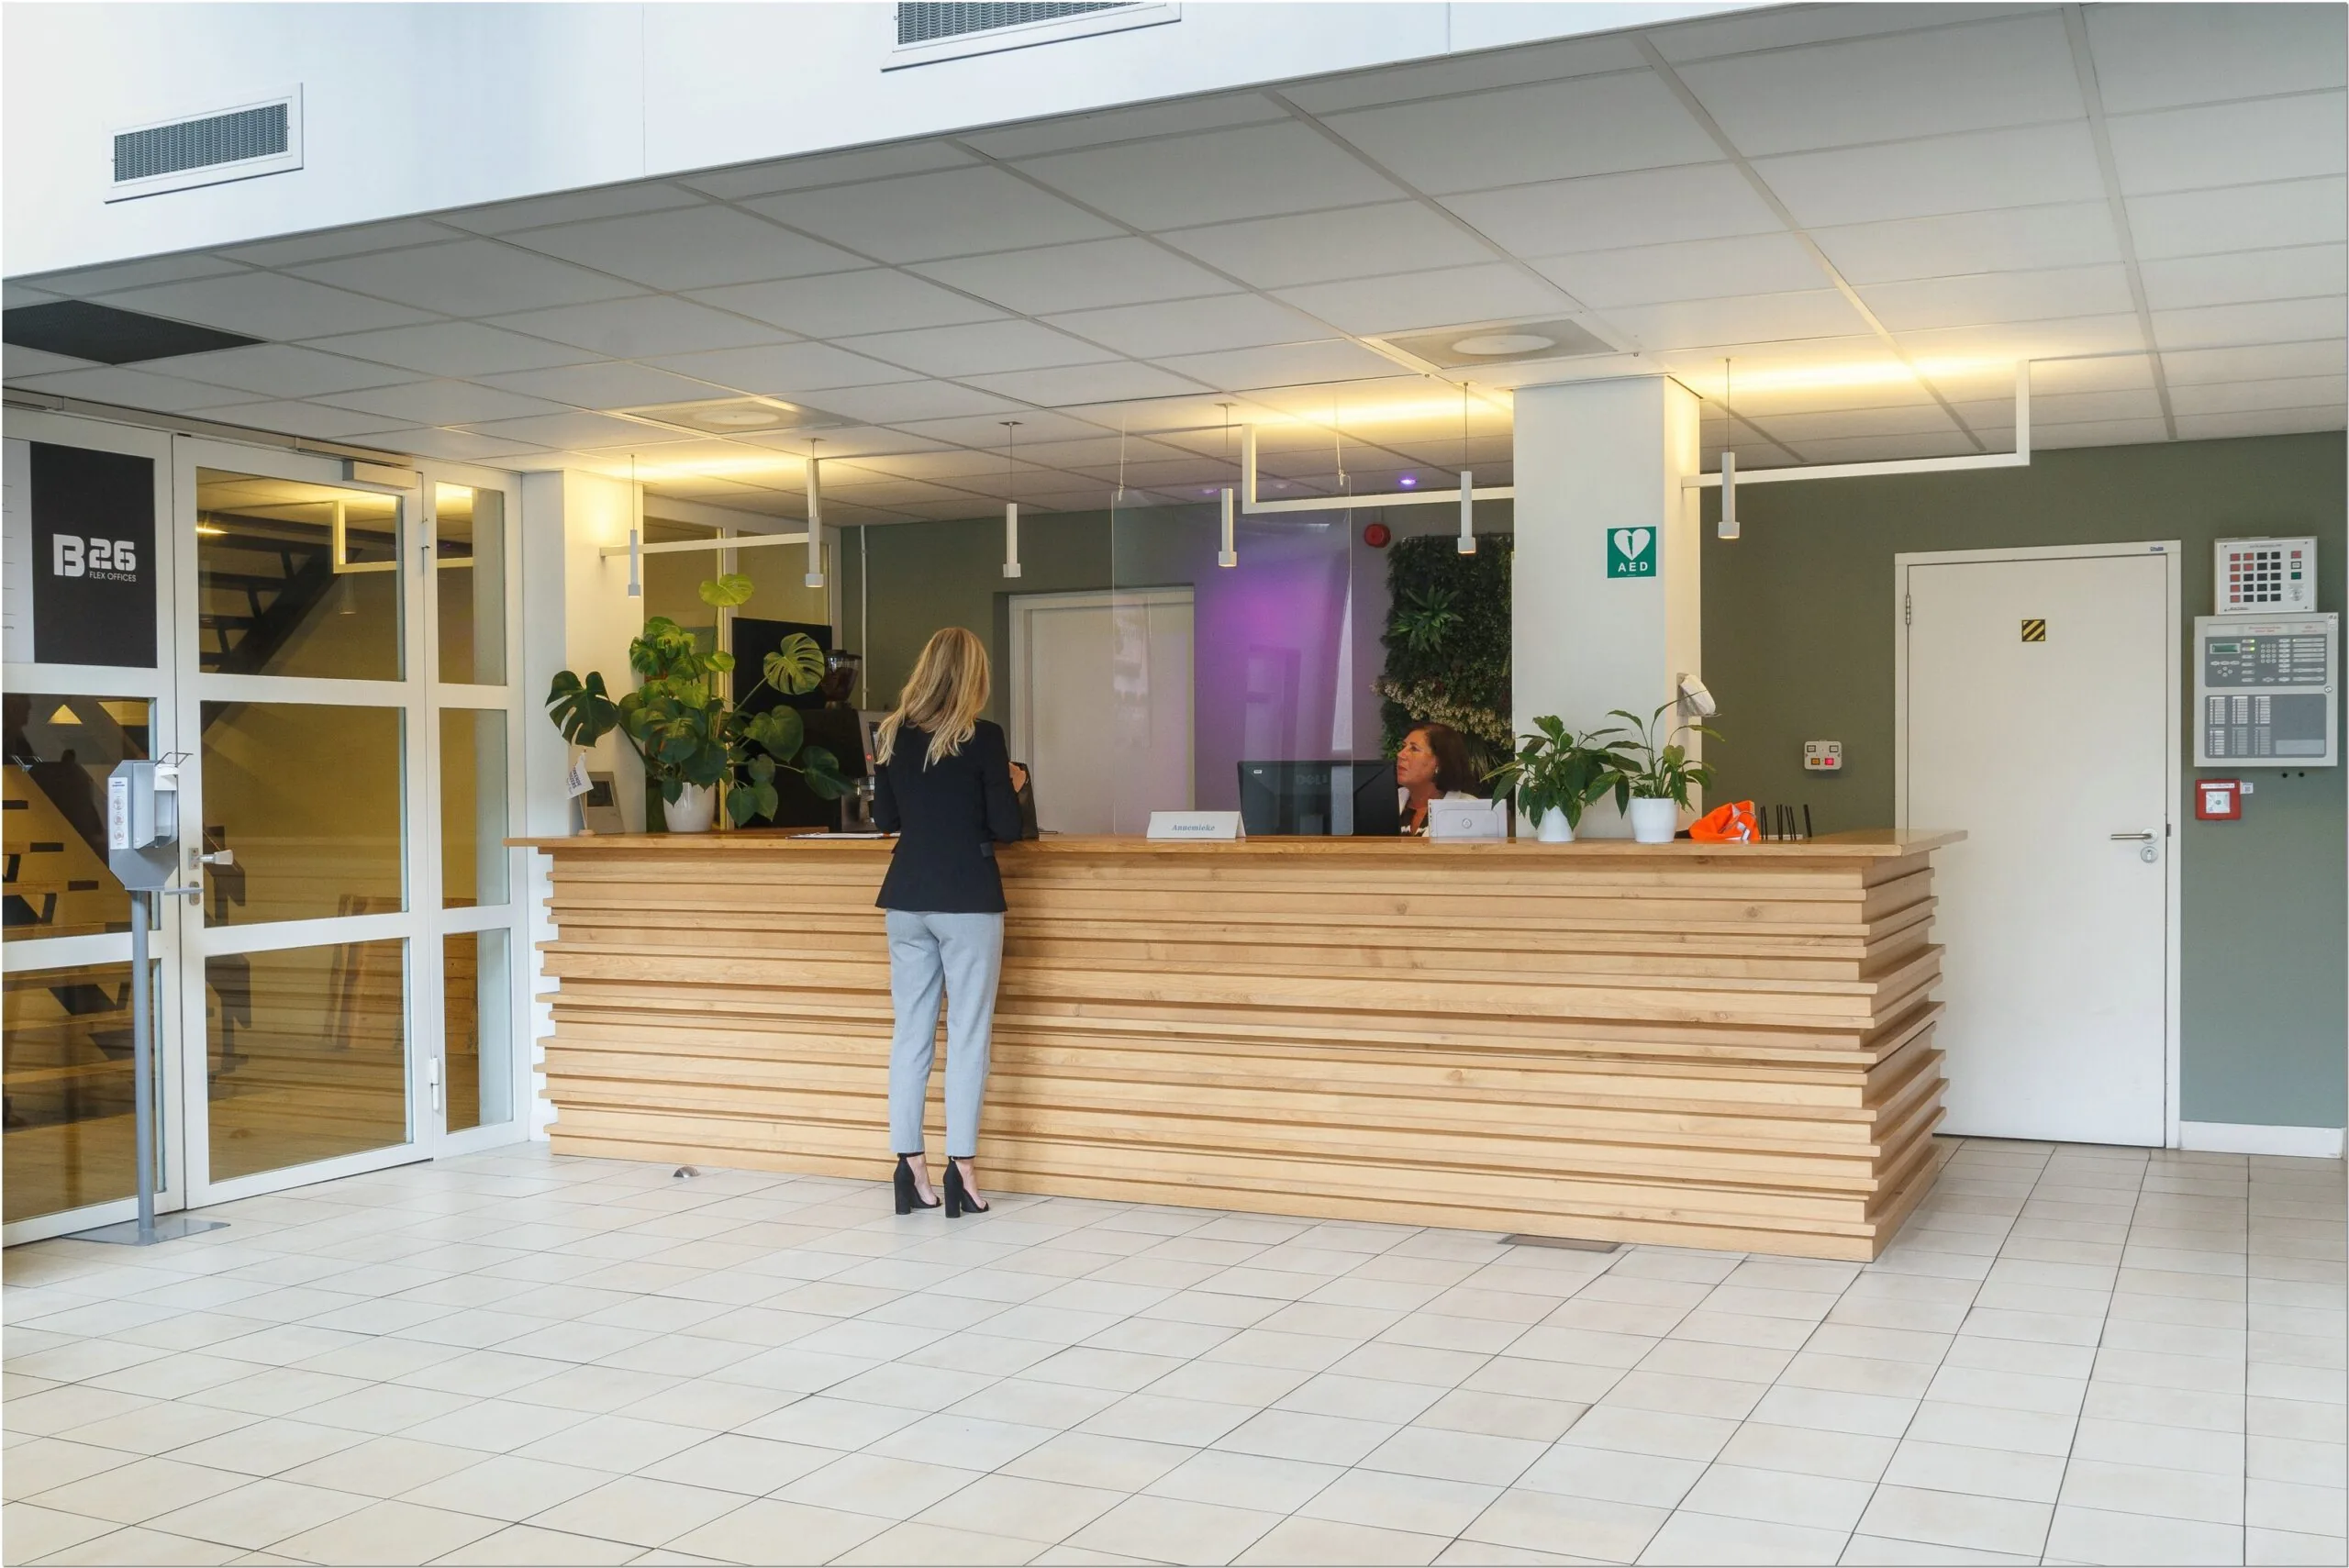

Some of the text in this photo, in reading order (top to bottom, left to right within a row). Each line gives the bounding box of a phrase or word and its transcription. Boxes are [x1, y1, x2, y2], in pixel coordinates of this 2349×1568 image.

[1618, 562, 1648, 573] AED
[89, 571, 137, 583] FLEX OFFICES
[1172, 823, 1216, 831] Annemieke
